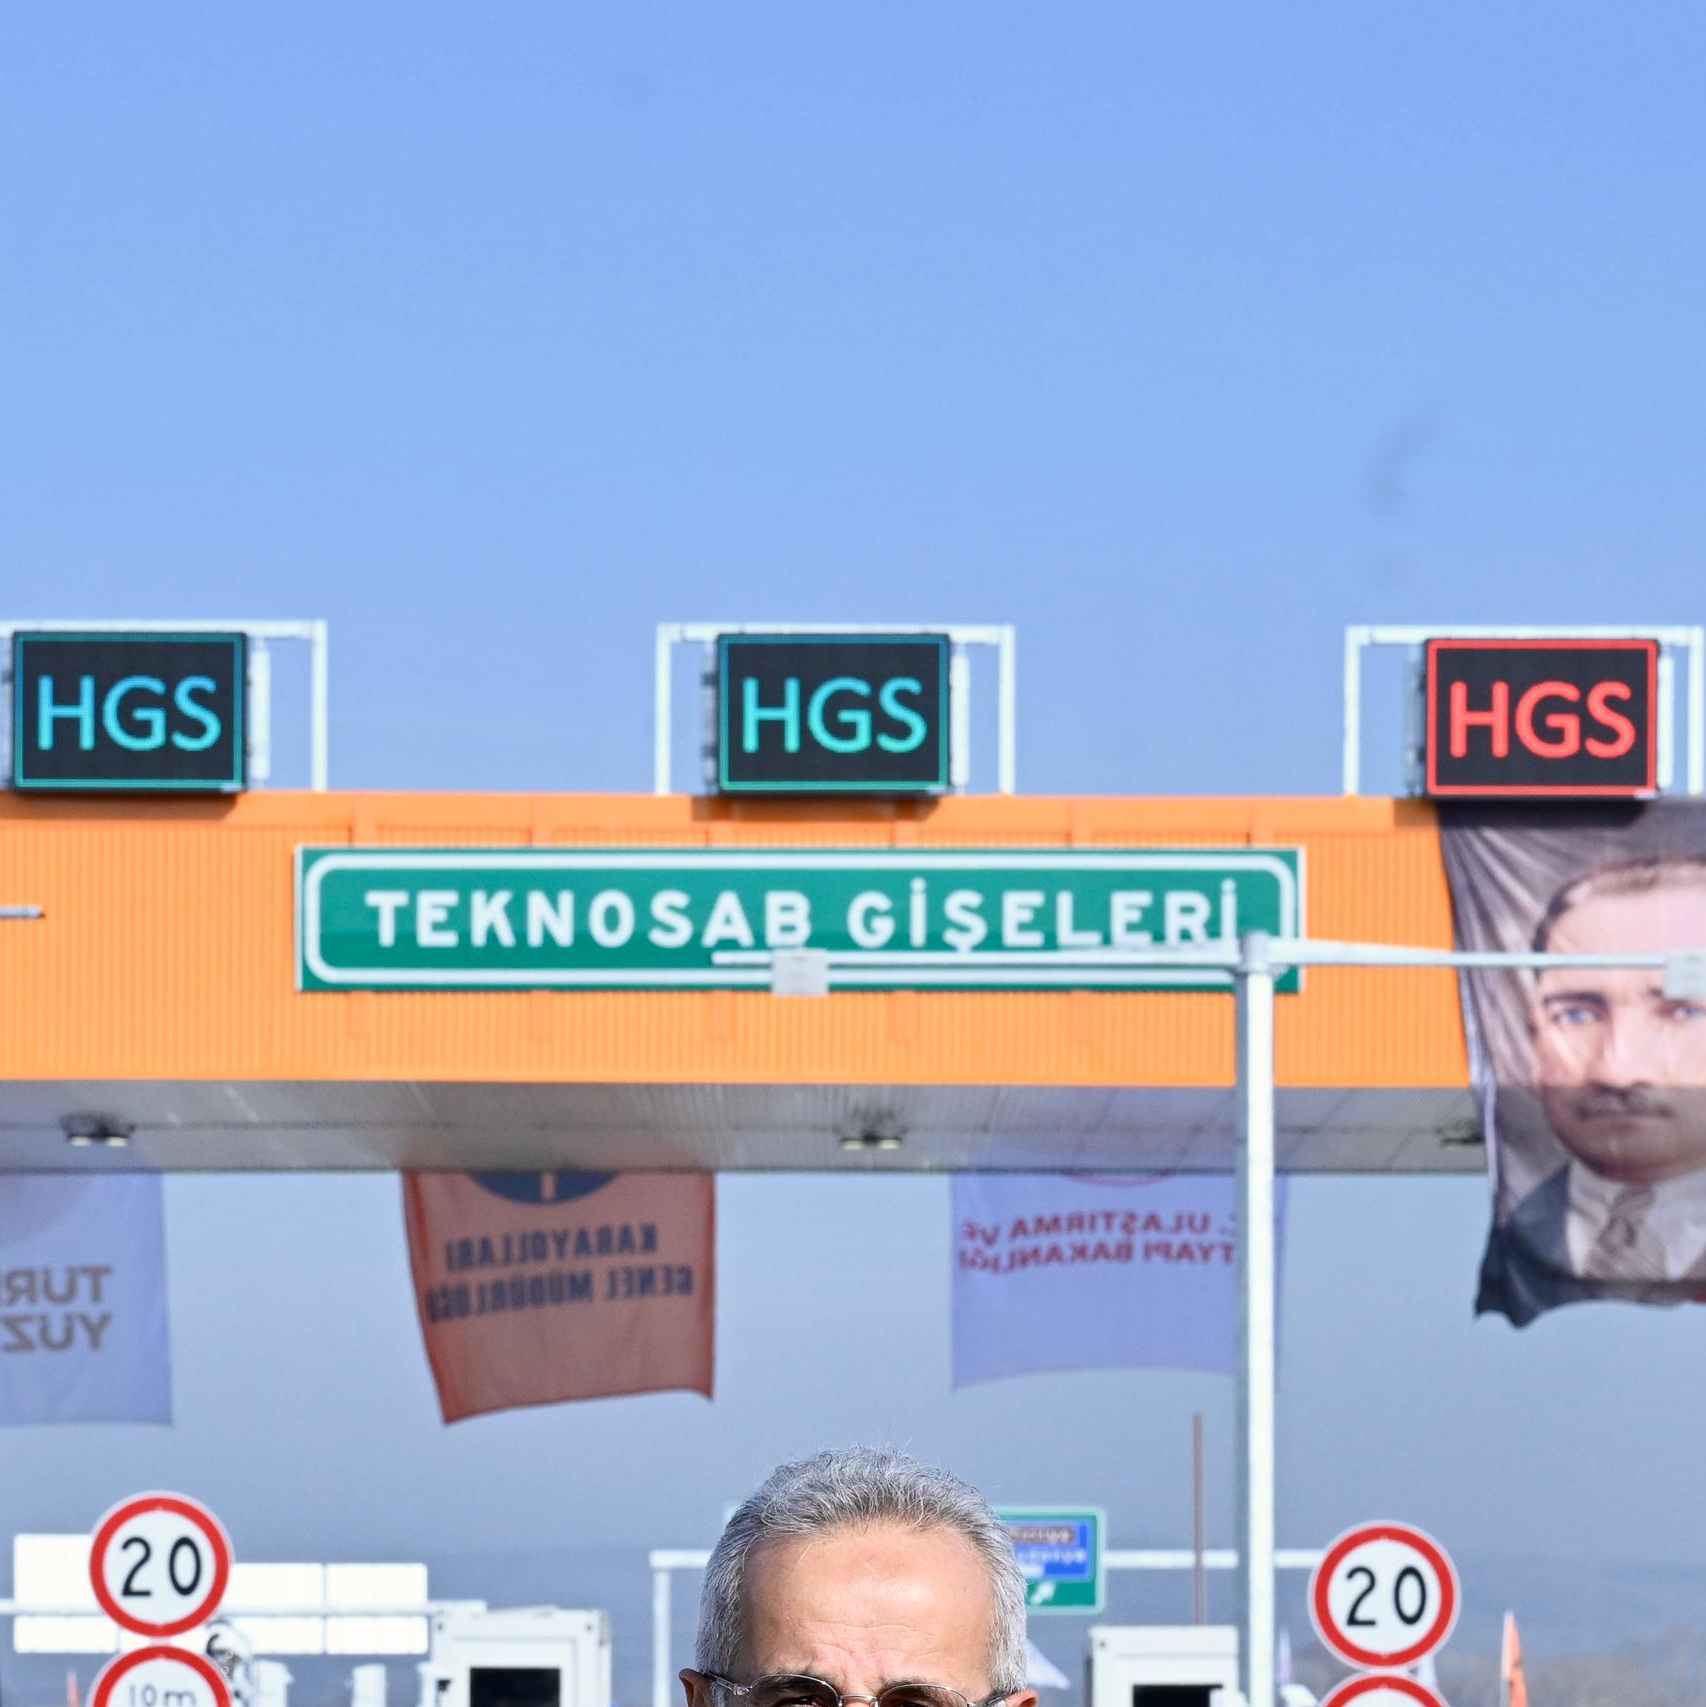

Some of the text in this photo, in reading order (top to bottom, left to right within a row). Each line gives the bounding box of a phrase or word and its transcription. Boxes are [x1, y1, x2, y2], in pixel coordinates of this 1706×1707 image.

[38, 675, 221, 751] HGS
[743, 677, 927, 753] HGS
[1450, 681, 1636, 758] HGS
[364, 877, 1239, 954] TEKNOSAB GİŞELERİ
[122, 1537, 201, 1596] 20
[1347, 1566, 1426, 1626] 20
